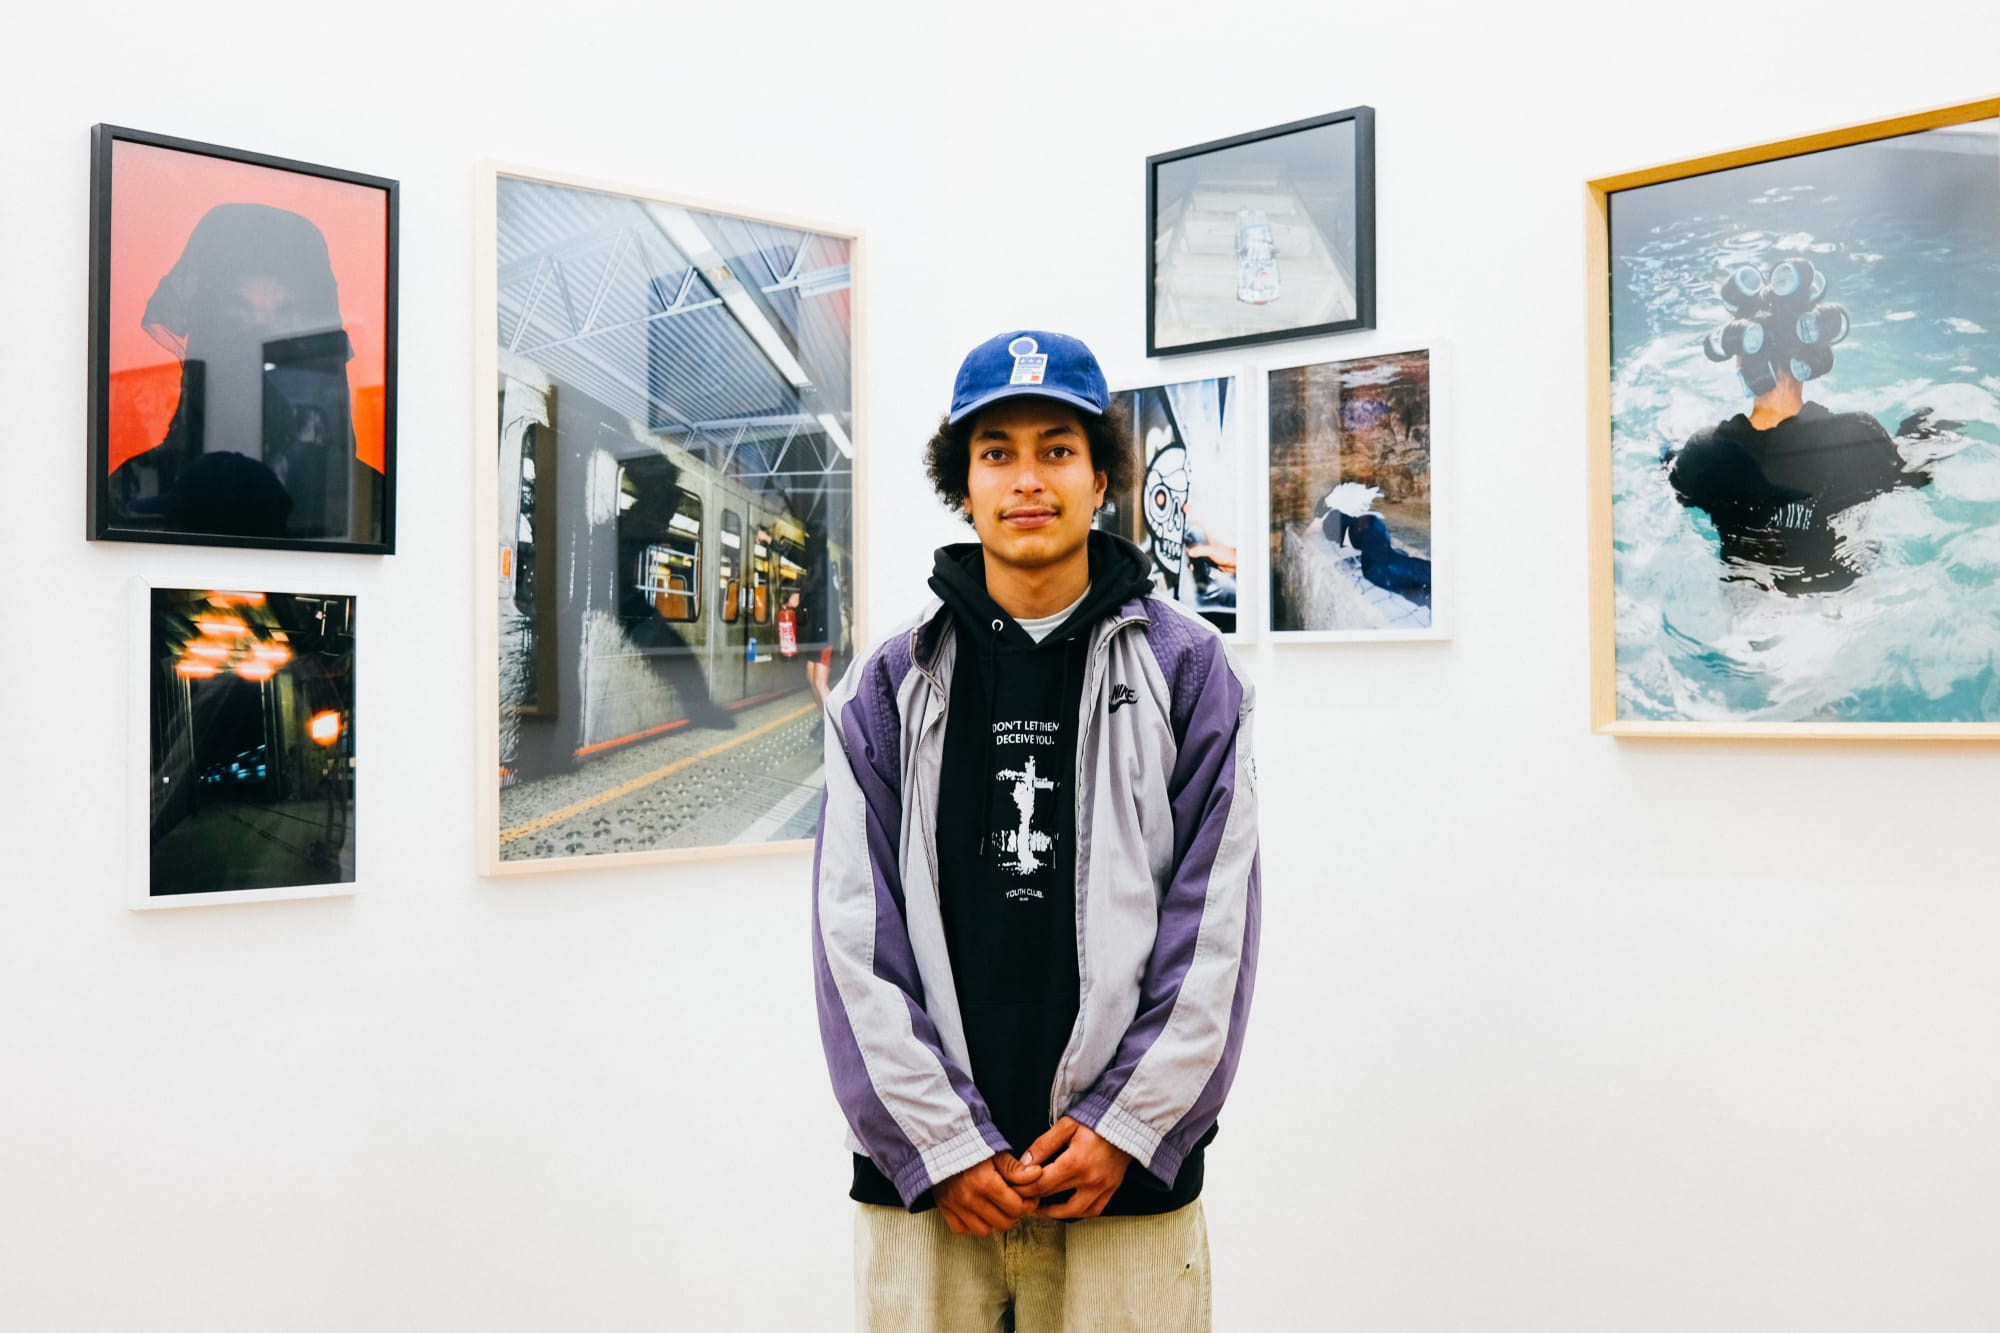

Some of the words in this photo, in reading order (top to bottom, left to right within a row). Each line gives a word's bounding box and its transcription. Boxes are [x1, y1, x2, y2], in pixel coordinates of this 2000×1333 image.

[1110, 684, 1135, 702] NIKE
[992, 720, 1022, 733] DON'T
[1024, 720, 1039, 731] LET
[996, 733, 1034, 745] DECEIVE
[1035, 735, 1055, 745] YOU.
[1005, 888, 1026, 899] YOUTH
